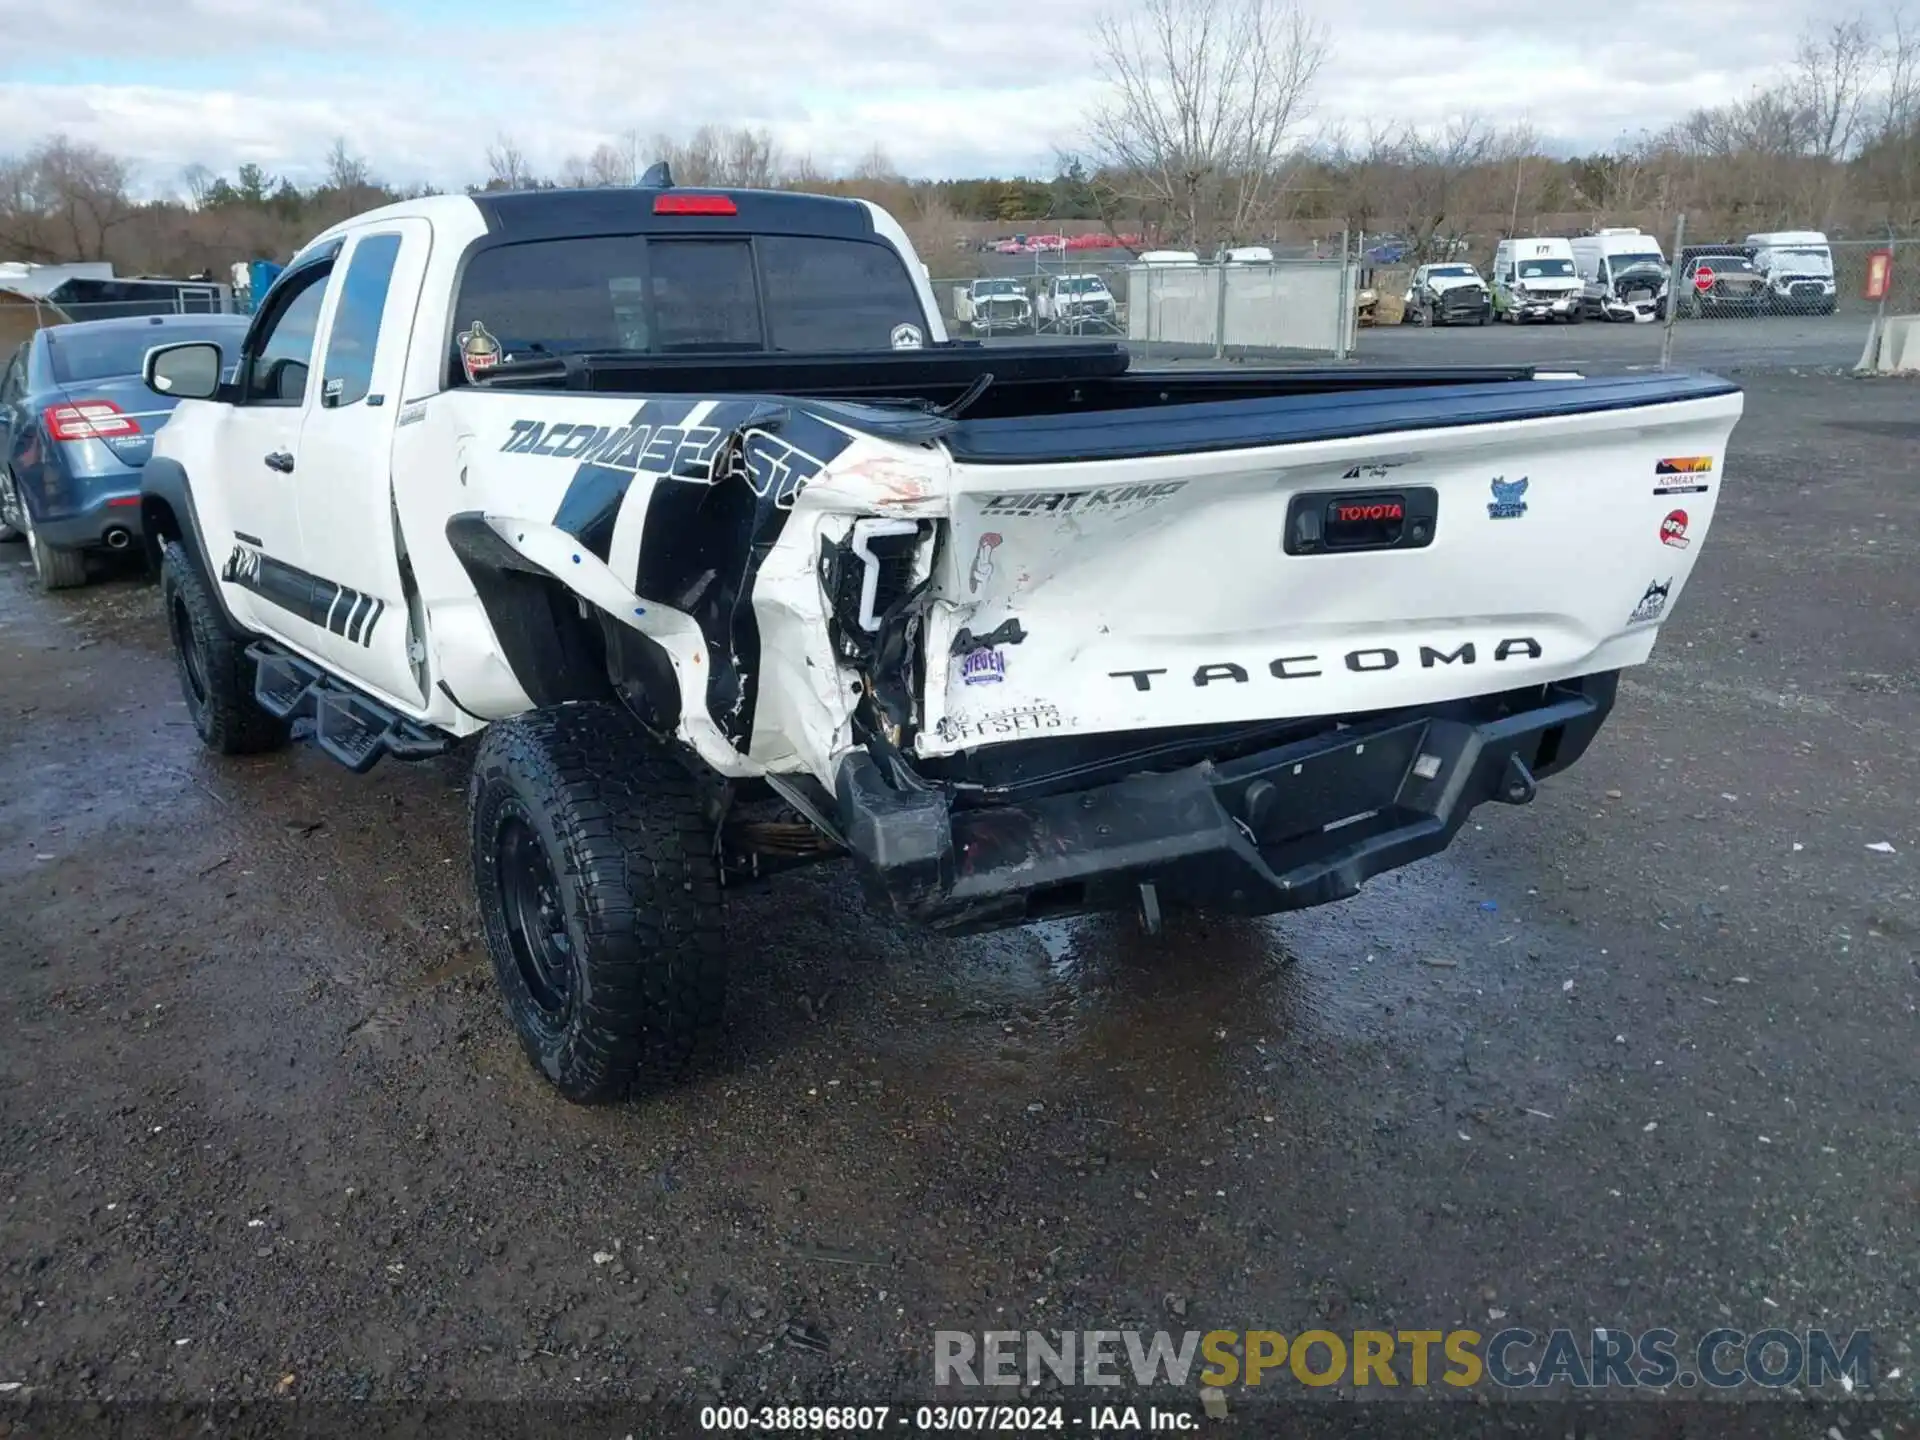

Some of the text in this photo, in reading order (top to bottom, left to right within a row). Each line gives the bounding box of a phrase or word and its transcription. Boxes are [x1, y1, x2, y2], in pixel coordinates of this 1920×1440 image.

[1695, 273, 1715, 284] STOP
[985, 490, 1090, 512] DIRT
[1340, 504, 1403, 521] TOYOTA
[1108, 637, 1543, 692] TACOMA
